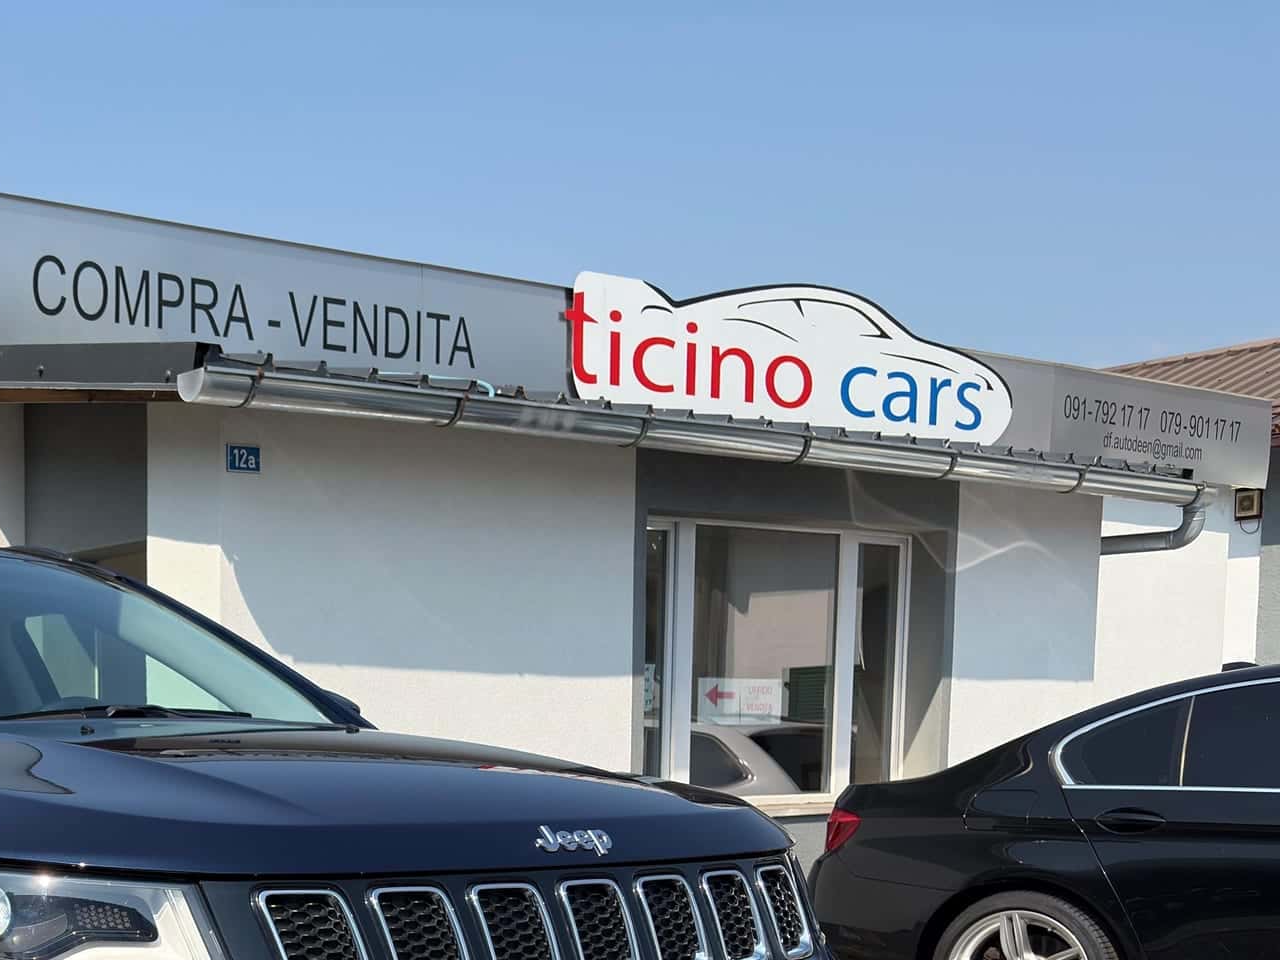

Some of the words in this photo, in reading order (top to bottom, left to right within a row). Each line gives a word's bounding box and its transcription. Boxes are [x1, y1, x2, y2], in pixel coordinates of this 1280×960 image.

[32, 254, 255, 341] COMPRA
[564, 291, 813, 409] ticino
[839, 365, 984, 431] cars
[1063, 394, 1117, 426] 091-792
[1160, 410, 1211, 439] 079-901
[232, 448, 257, 469] 12a
[535, 825, 613, 857] Jeep
